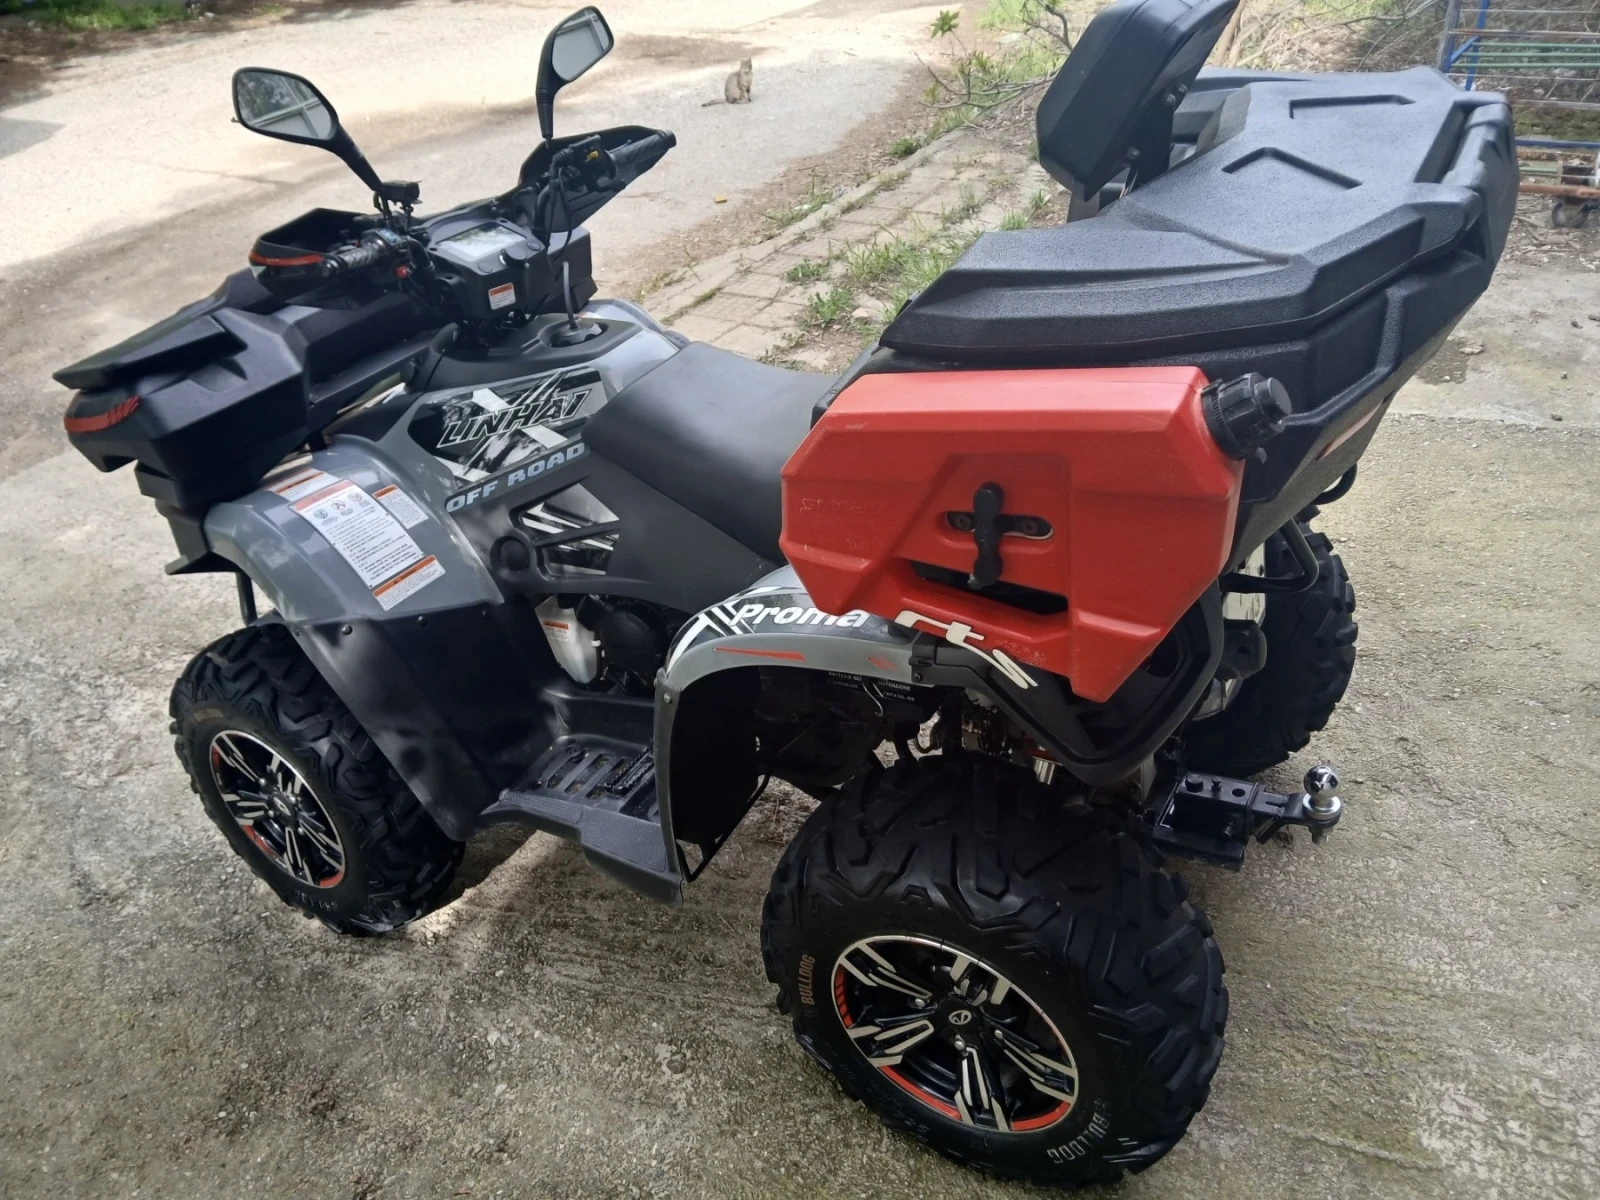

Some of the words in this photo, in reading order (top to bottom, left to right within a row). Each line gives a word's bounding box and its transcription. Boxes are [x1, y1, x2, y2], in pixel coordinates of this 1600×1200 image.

[436, 388, 592, 448] LINHAI
[446, 480, 499, 513] OFF
[507, 442, 585, 486] ROAD
[798, 953, 816, 1005] BULLDOG
